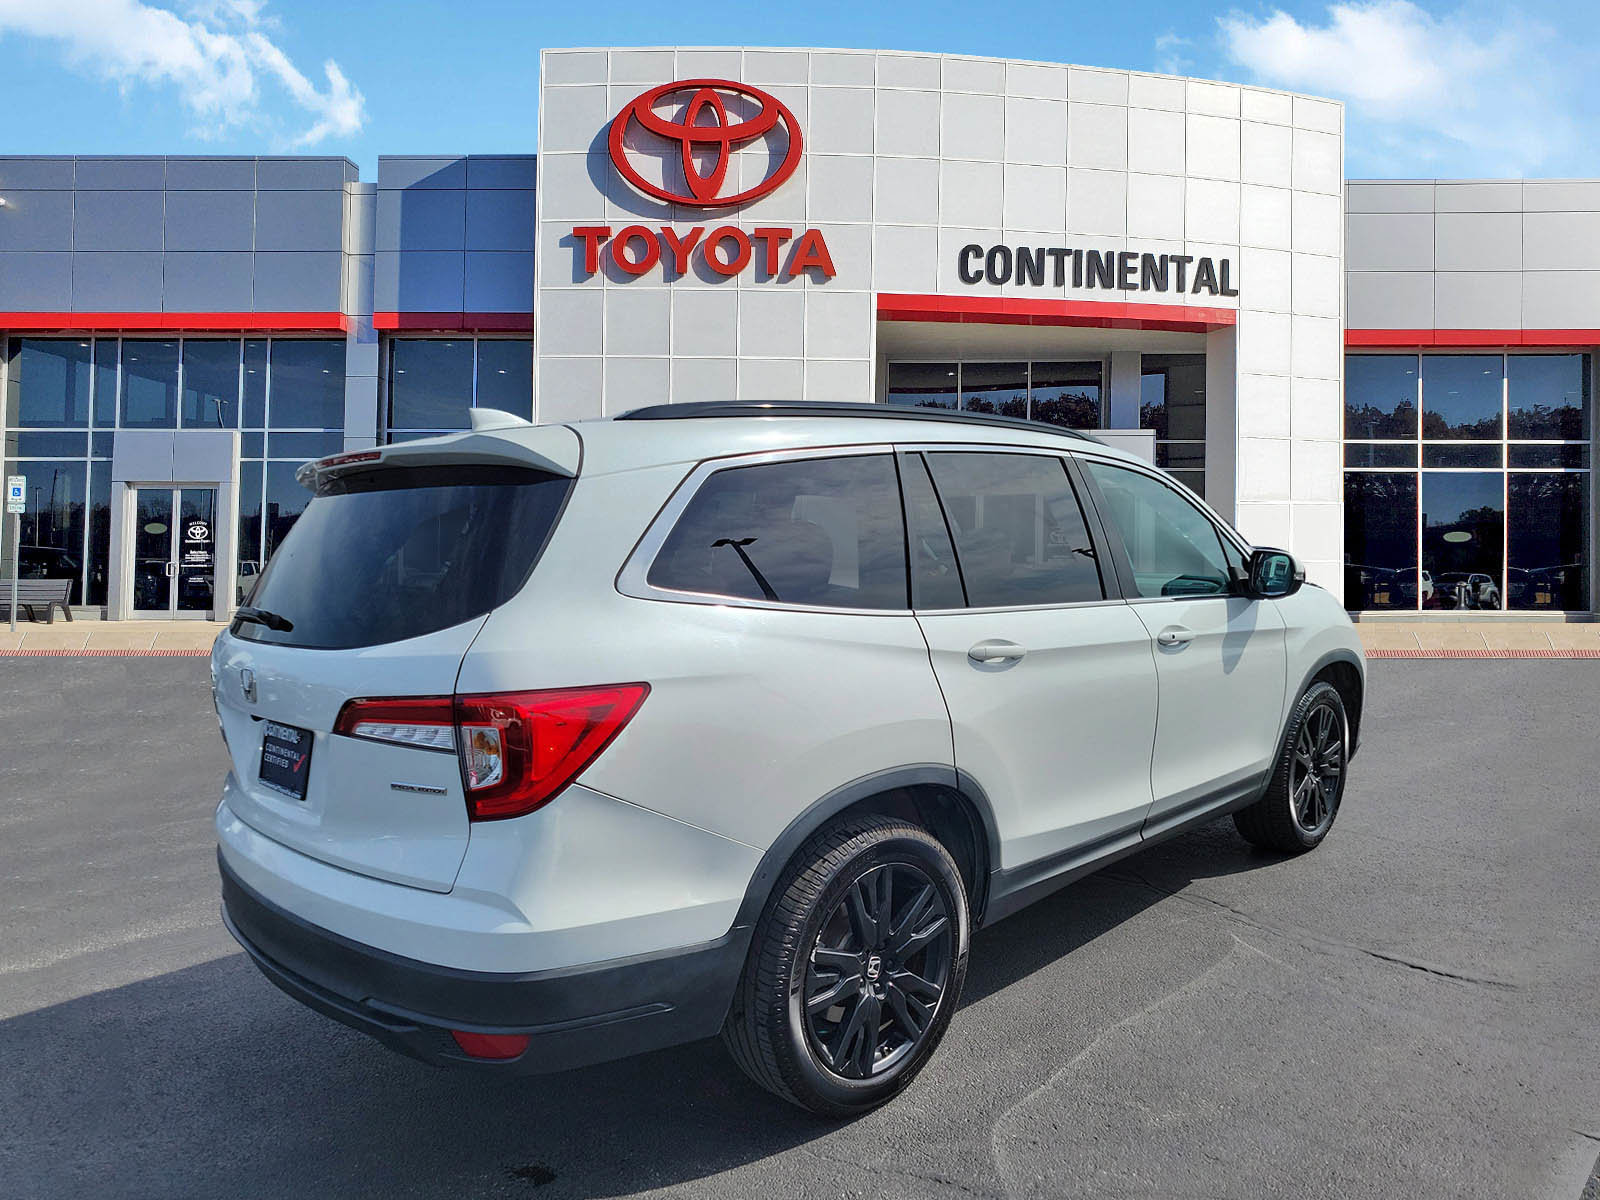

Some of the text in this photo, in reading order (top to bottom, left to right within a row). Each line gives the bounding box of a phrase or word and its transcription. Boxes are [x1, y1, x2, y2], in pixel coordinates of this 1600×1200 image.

[572, 225, 837, 277] TOYOTA
[958, 244, 1239, 297] CONTINENTAL
[263, 752, 289, 768] CERTIFIED
[265, 743, 300, 761] CONTINENTAL
